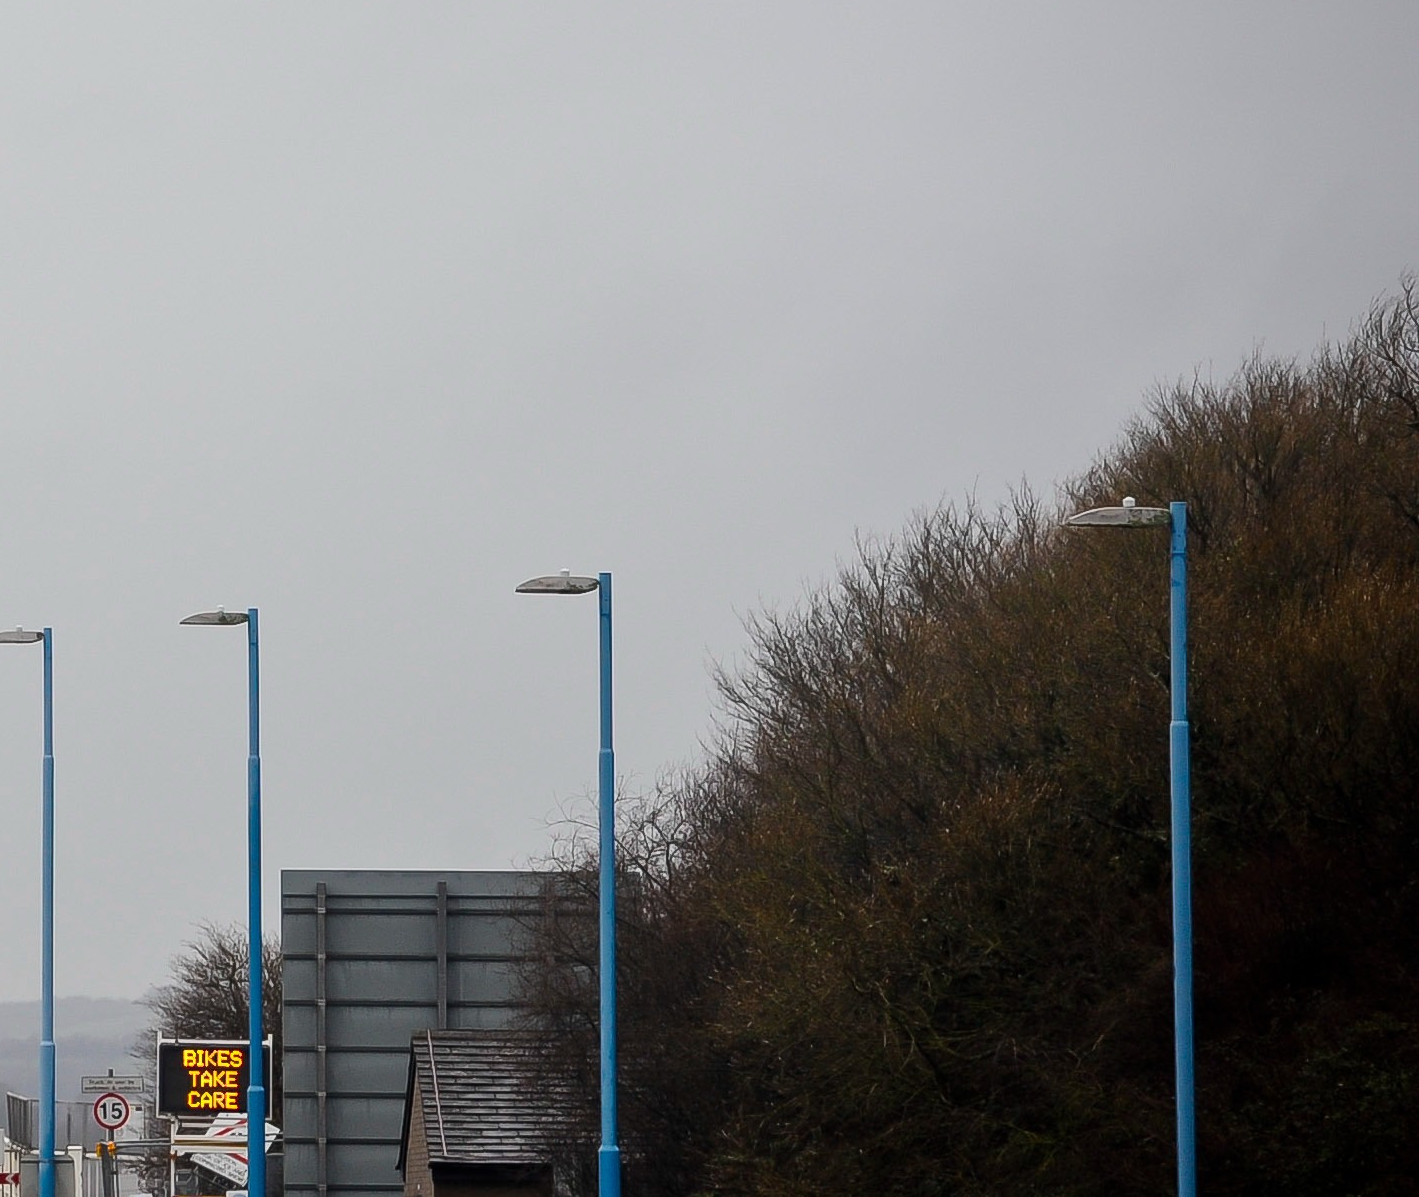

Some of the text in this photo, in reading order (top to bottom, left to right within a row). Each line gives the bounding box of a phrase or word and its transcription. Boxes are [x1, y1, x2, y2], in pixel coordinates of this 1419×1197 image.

[182, 1049, 243, 1068] BIKES
[188, 1070, 238, 1088] TAKE
[187, 1090, 238, 1110] CARE
[99, 1101, 123, 1120] 15
